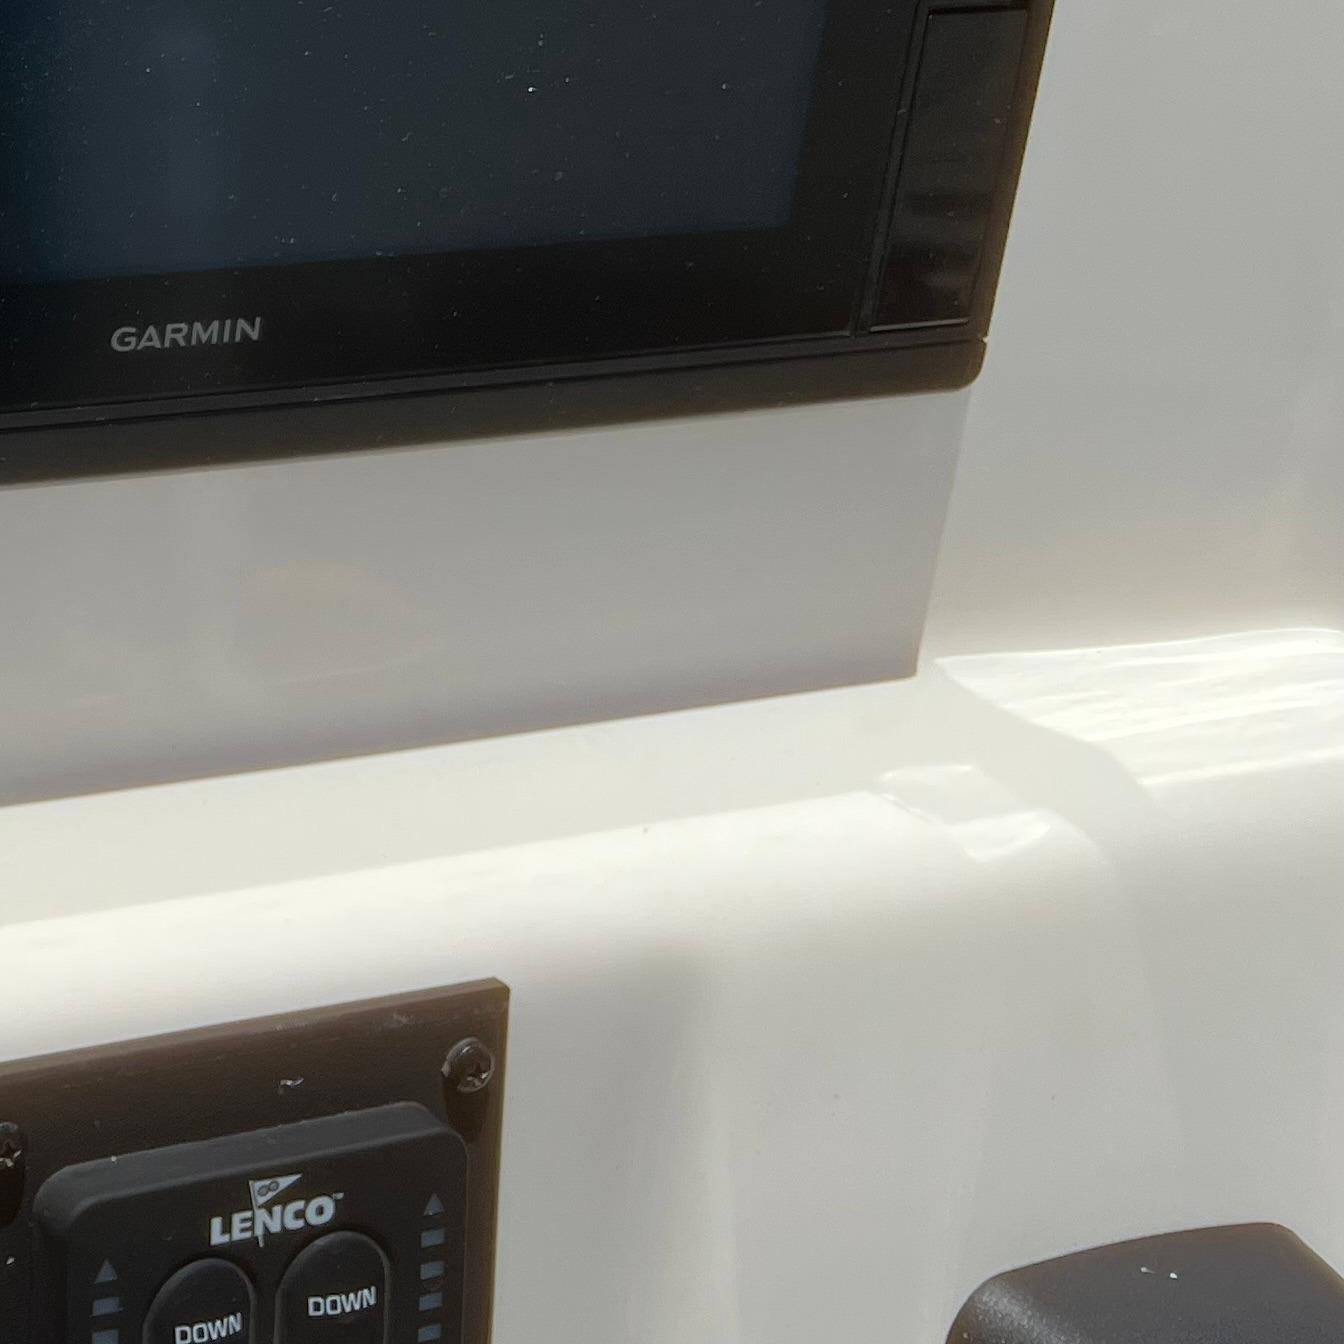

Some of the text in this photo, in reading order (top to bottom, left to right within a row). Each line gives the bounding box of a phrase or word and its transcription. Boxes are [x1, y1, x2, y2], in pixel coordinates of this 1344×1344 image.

[110, 316, 261, 352] GARMIN
[210, 1194, 337, 1247] LENCO
[307, 1285, 378, 1317] DOWN
[174, 1312, 243, 1344] DOWN
